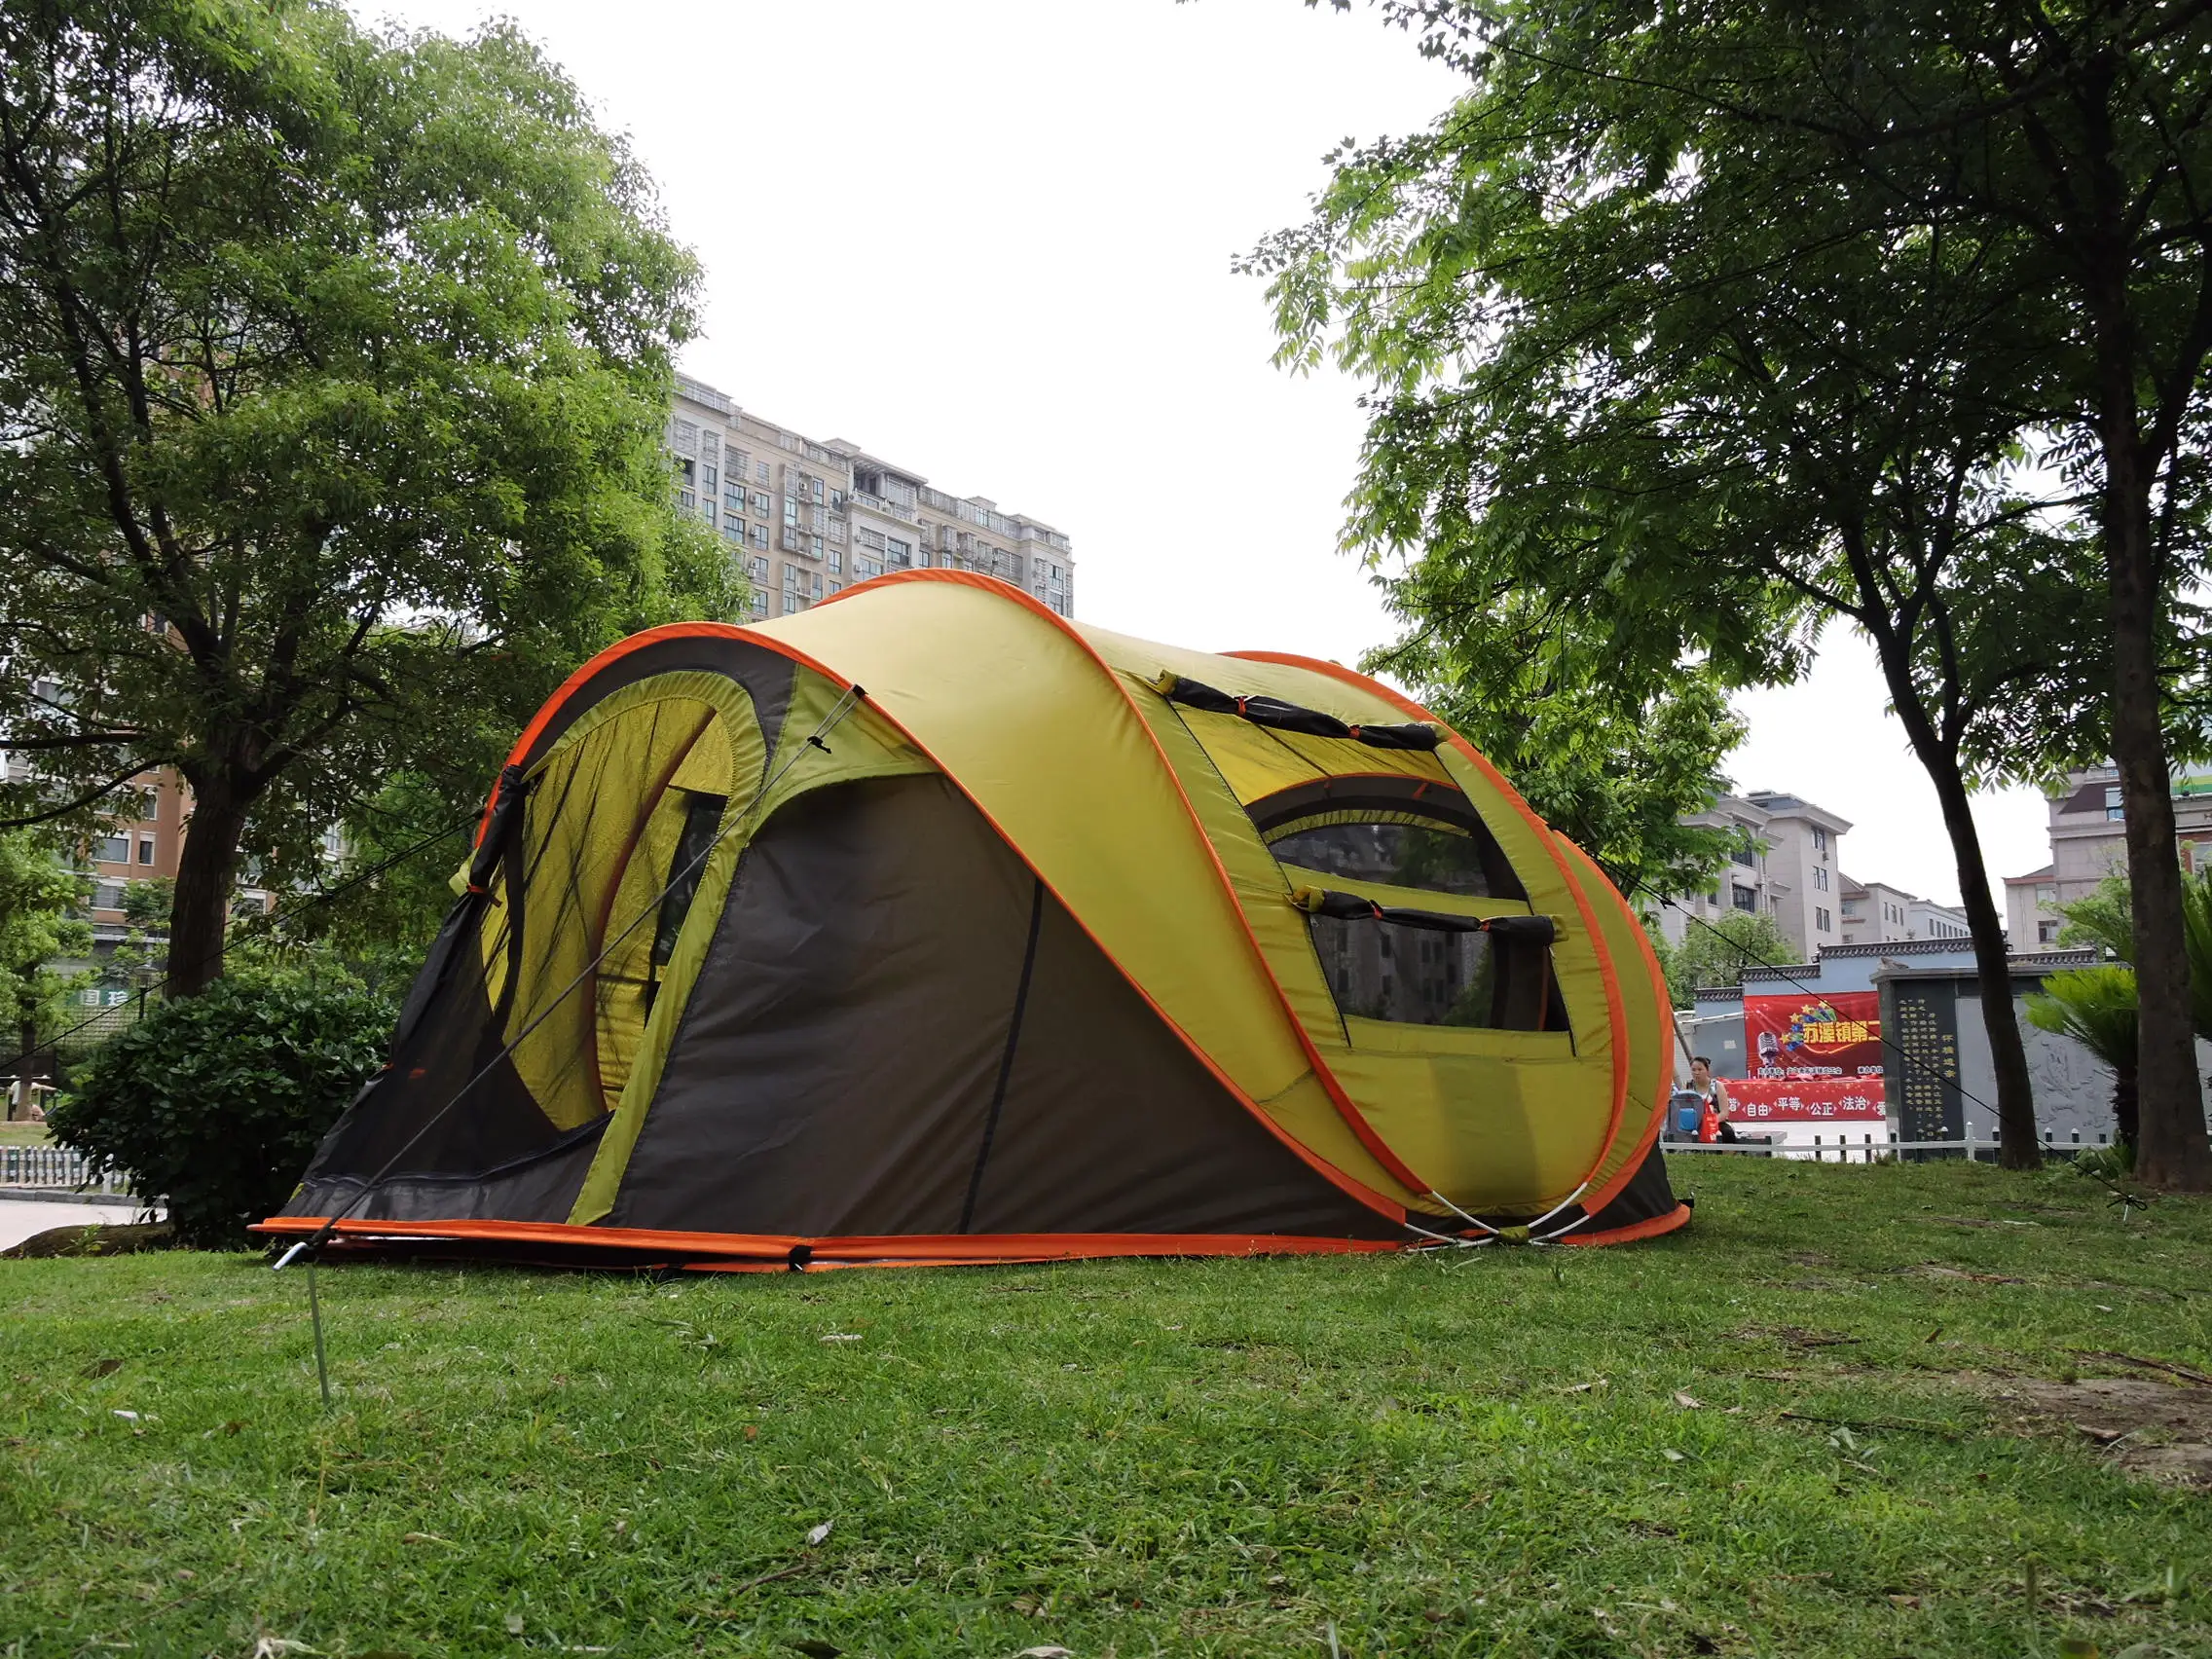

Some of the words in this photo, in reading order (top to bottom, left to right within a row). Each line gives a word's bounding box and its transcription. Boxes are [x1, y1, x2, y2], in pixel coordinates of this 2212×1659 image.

[1747, 1103, 1769, 1117] 自由
[1778, 1097, 1800, 1111] 平等
[1810, 1102, 1834, 1116] 公正
[1843, 1096, 1866, 1111] 法治
